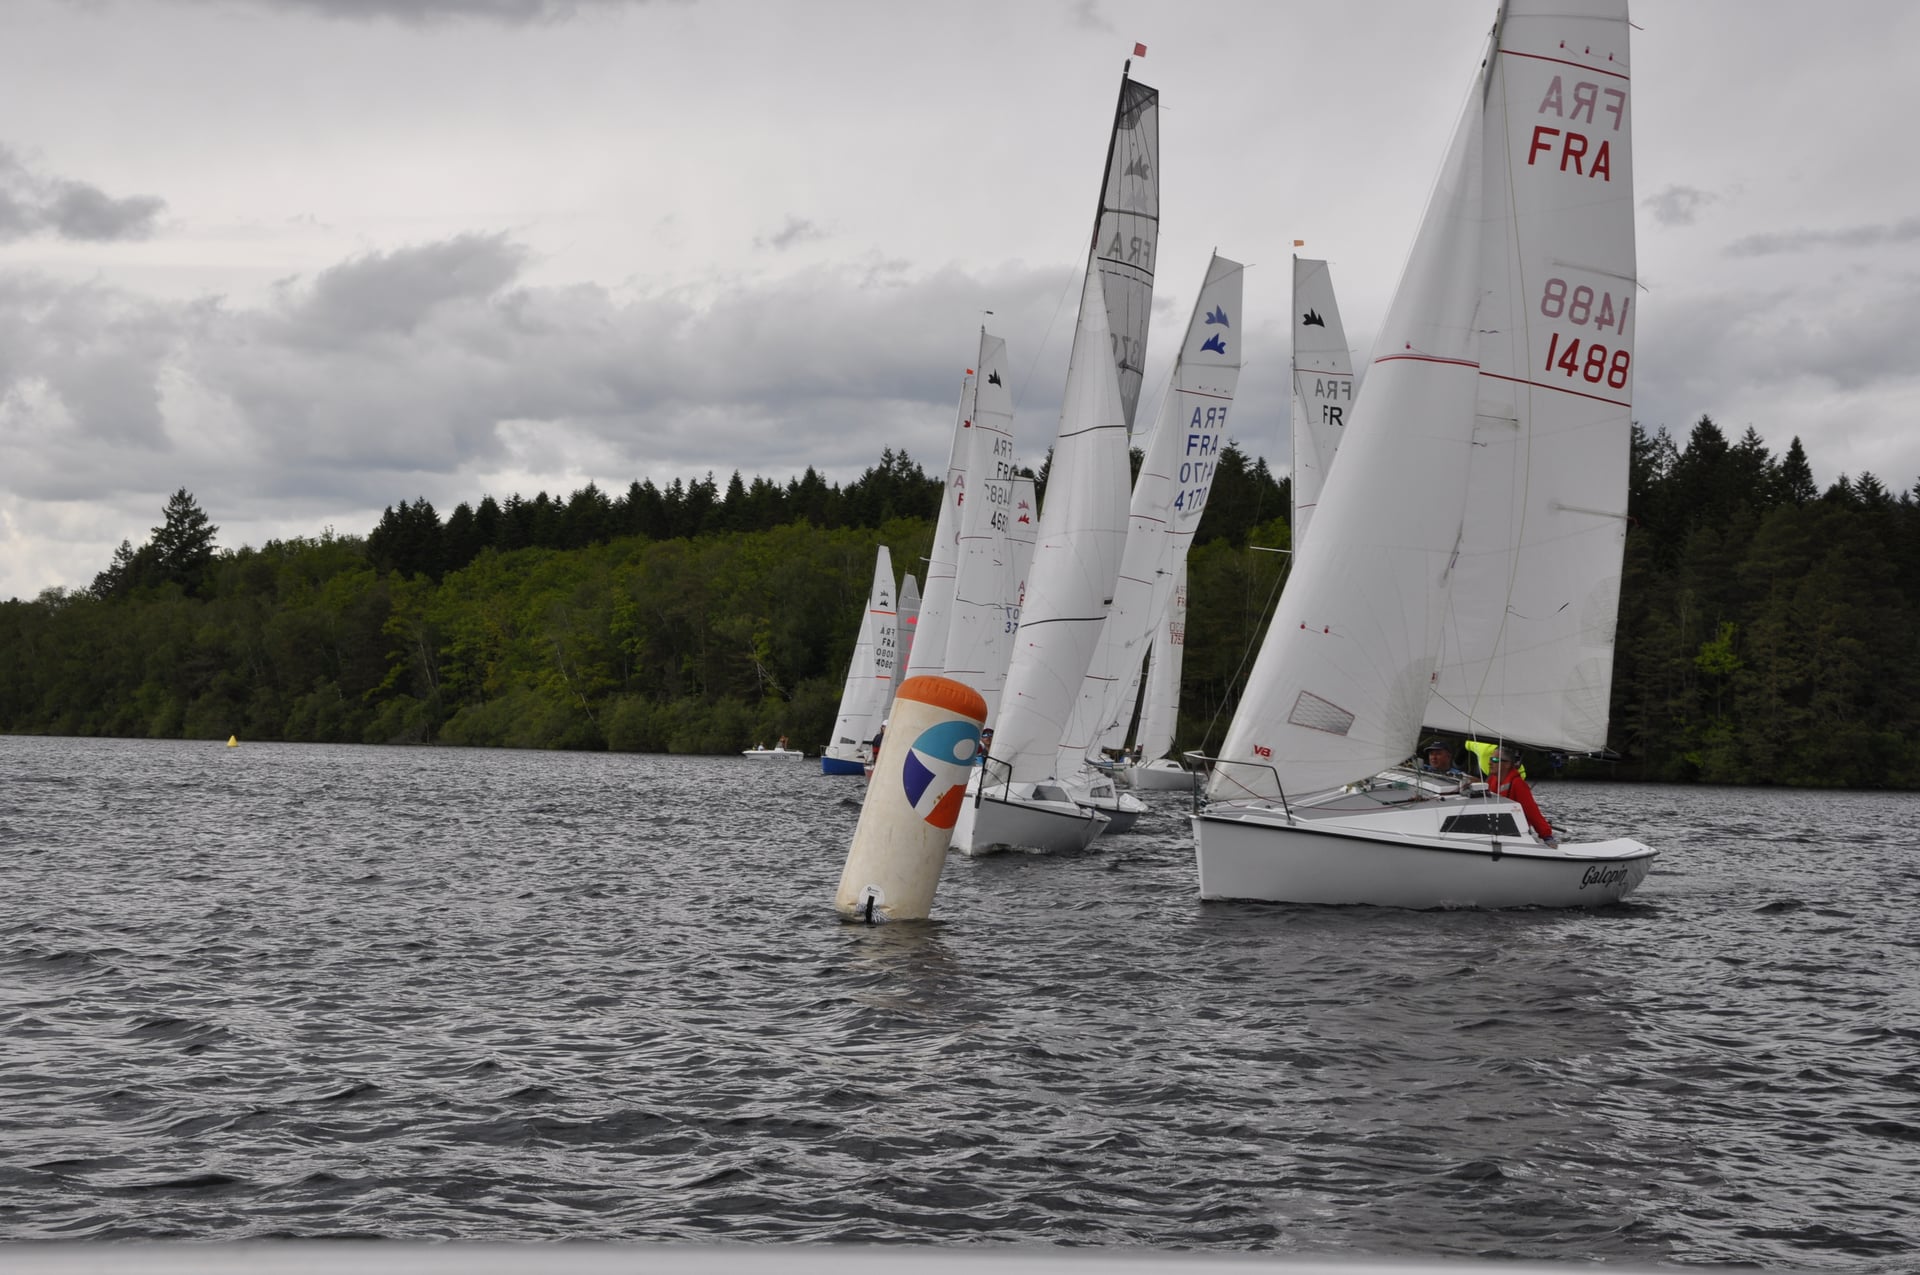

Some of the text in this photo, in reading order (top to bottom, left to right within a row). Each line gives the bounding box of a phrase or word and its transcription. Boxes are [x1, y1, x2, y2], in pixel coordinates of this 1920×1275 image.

[1528, 125, 1610, 182] FRA
[1545, 332, 1630, 390] 1488
[1186, 434, 1218, 456] FRA
[1174, 487, 1207, 511] 4170
[881, 637, 896, 648] FRA
